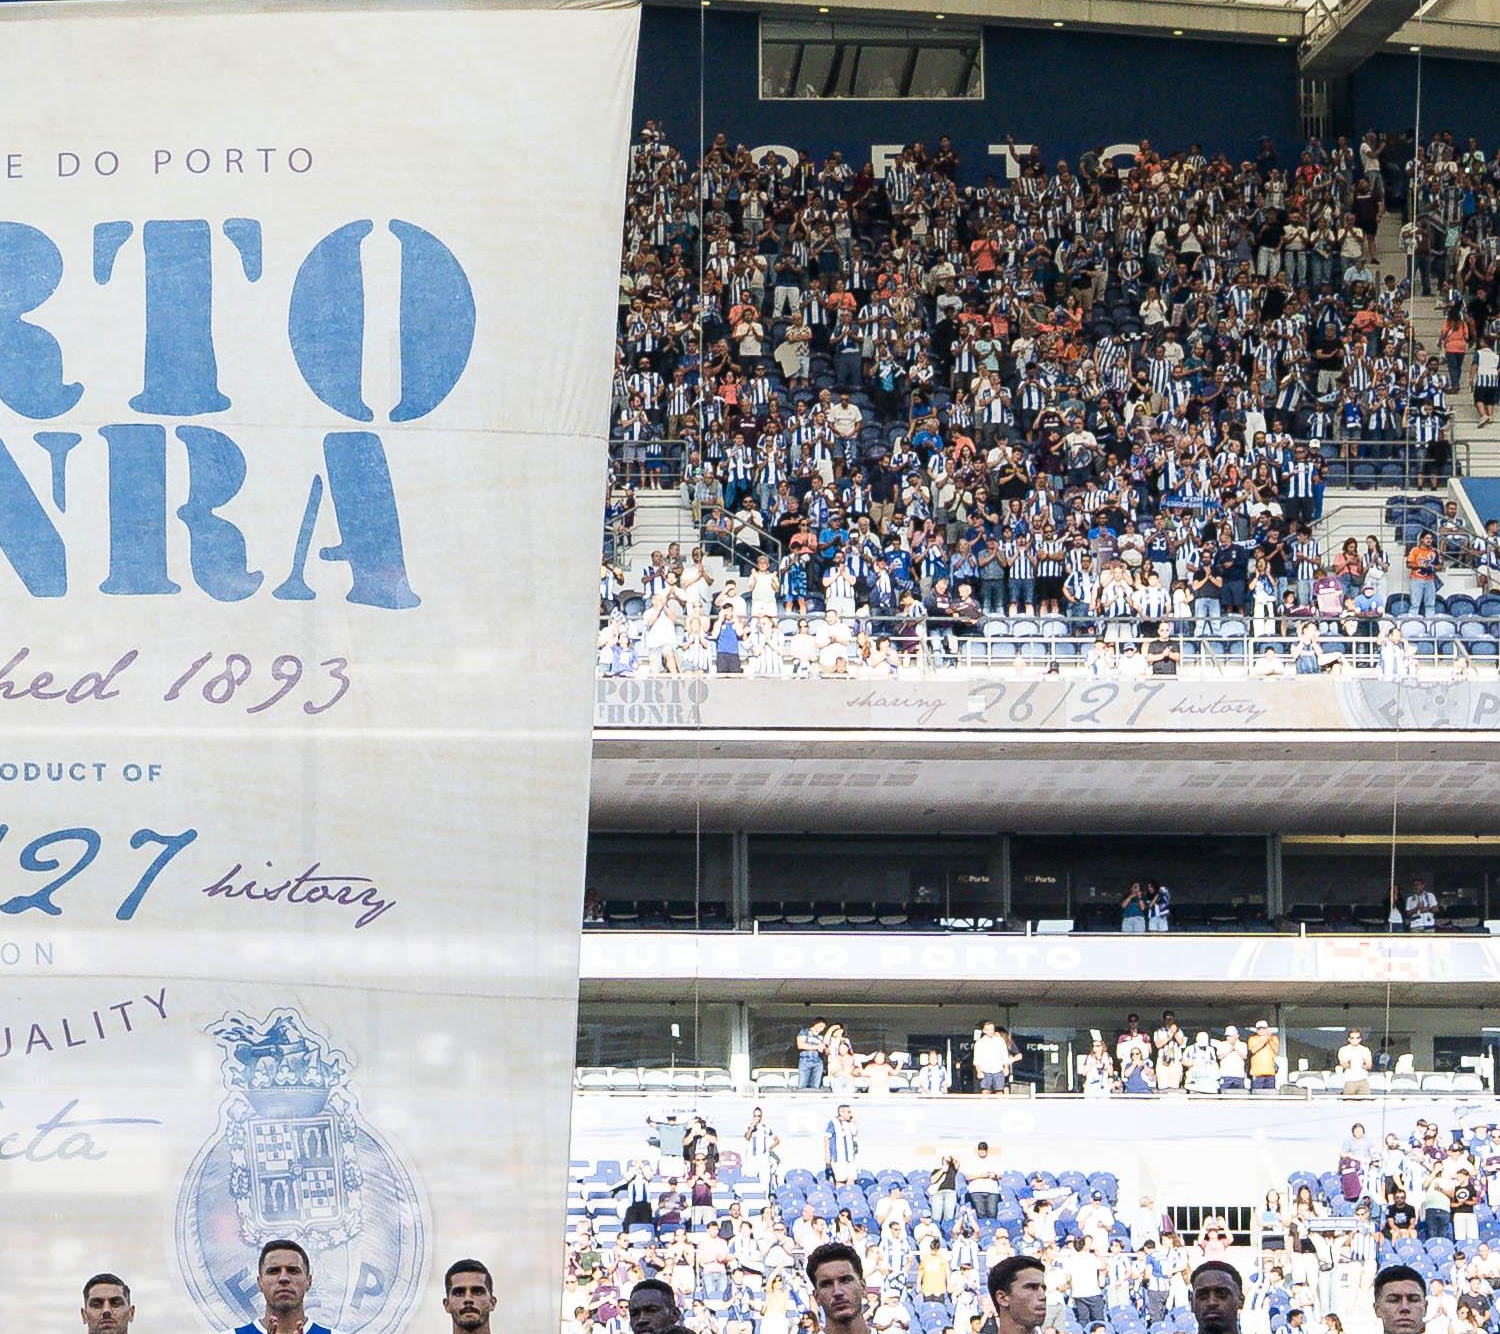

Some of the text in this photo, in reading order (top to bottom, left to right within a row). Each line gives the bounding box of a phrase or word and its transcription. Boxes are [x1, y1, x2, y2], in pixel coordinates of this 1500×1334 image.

[57, 150, 120, 179] DO
[153, 147, 318, 177] PORTO
[164, 650, 356, 716] 1893
[595, 679, 710, 704] PORTO
[845, 689, 947, 724] sharing
[958, 682, 1166, 722] 26/27
[125, 762, 164, 783] OF
[202, 859, 403, 930] history
[873, 945, 1083, 971] PORTO
